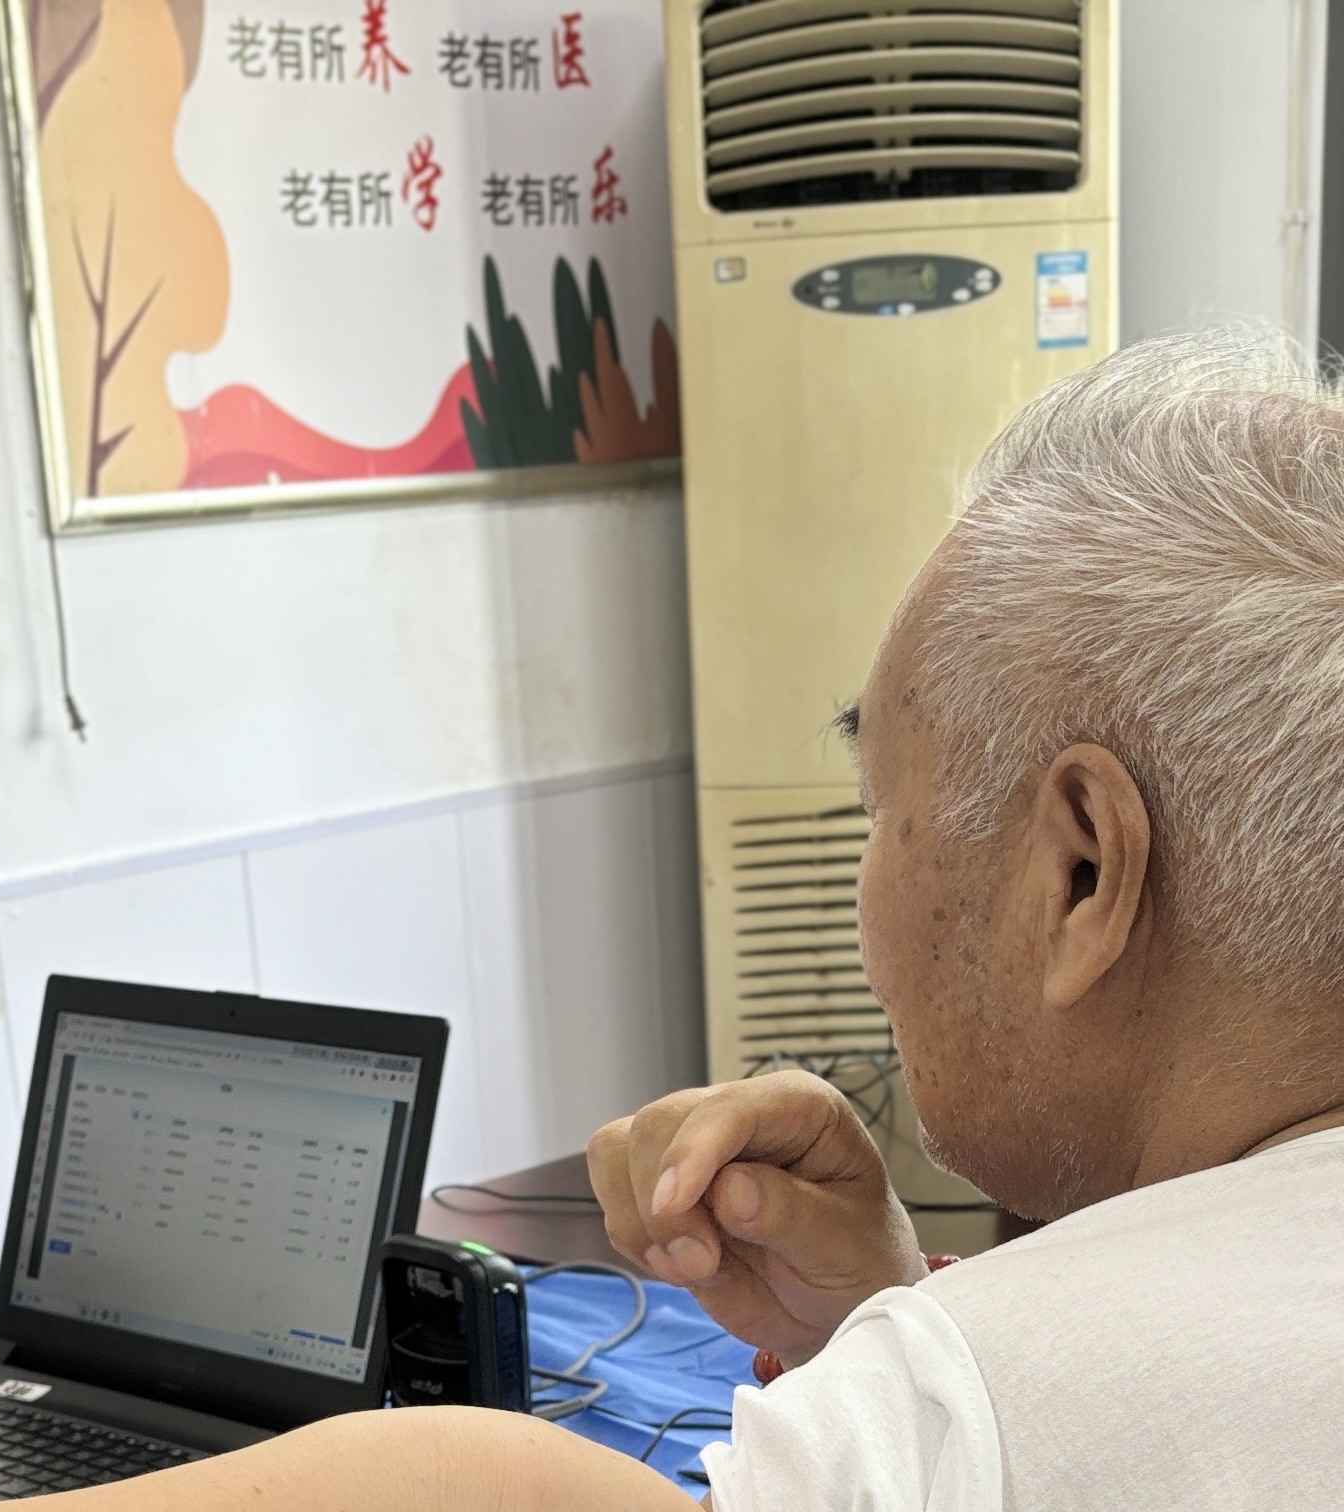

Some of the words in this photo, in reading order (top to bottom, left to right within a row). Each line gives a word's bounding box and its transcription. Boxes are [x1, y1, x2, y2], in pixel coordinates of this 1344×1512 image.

[227, 0, 411, 93] 老有所养
[438, 12, 591, 92] 老有所医
[280, 133, 443, 232] 老有所学
[481, 145, 628, 229] 老有所乐
